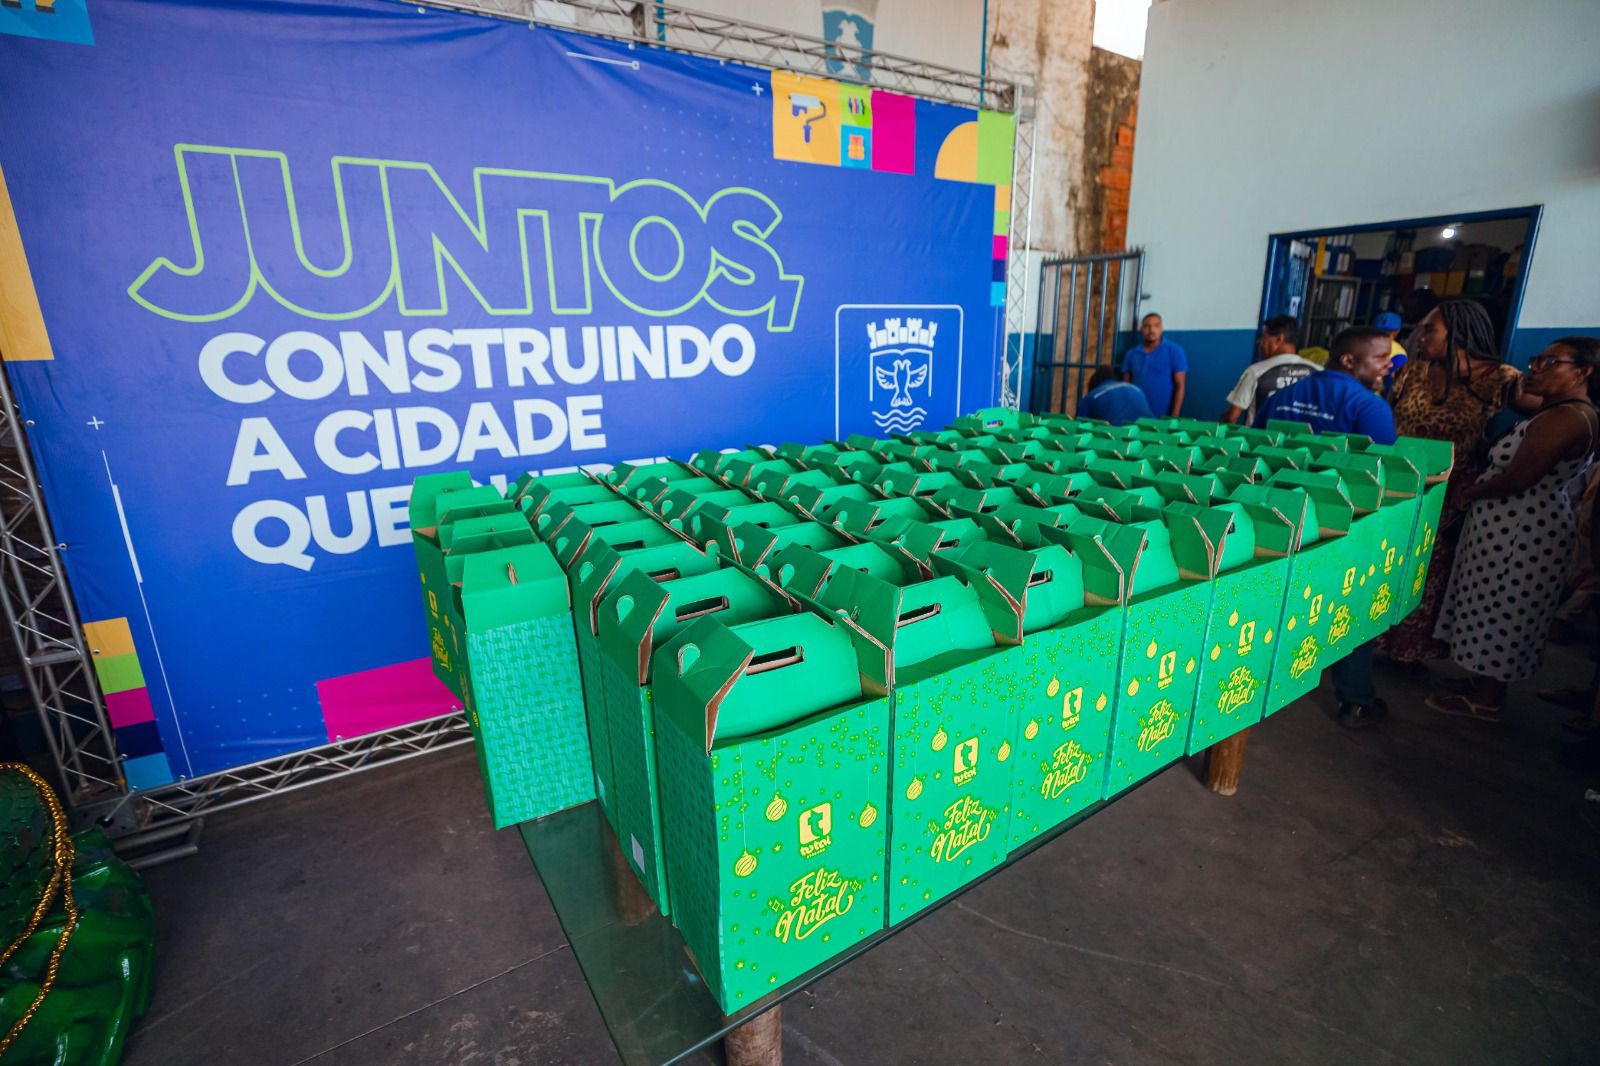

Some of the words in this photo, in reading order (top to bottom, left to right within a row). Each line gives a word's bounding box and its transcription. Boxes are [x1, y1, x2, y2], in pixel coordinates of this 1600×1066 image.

[127, 142, 804, 332] JUNTOS,
[198, 322, 756, 404] CONSTRUINDO
[226, 417, 307, 486] A
[313, 394, 606, 475] CIDADE
[231, 483, 411, 571] QUE
[1138, 711, 1174, 752] Natal
[1149, 699, 1173, 722] Feliz
[1041, 756, 1087, 799] Natal
[1053, 740, 1082, 770] Feliz
[943, 796, 983, 830] Feliz
[930, 813, 990, 863] Natal
[790, 868, 841, 908] Feliz
[775, 882, 853, 943] Natal
